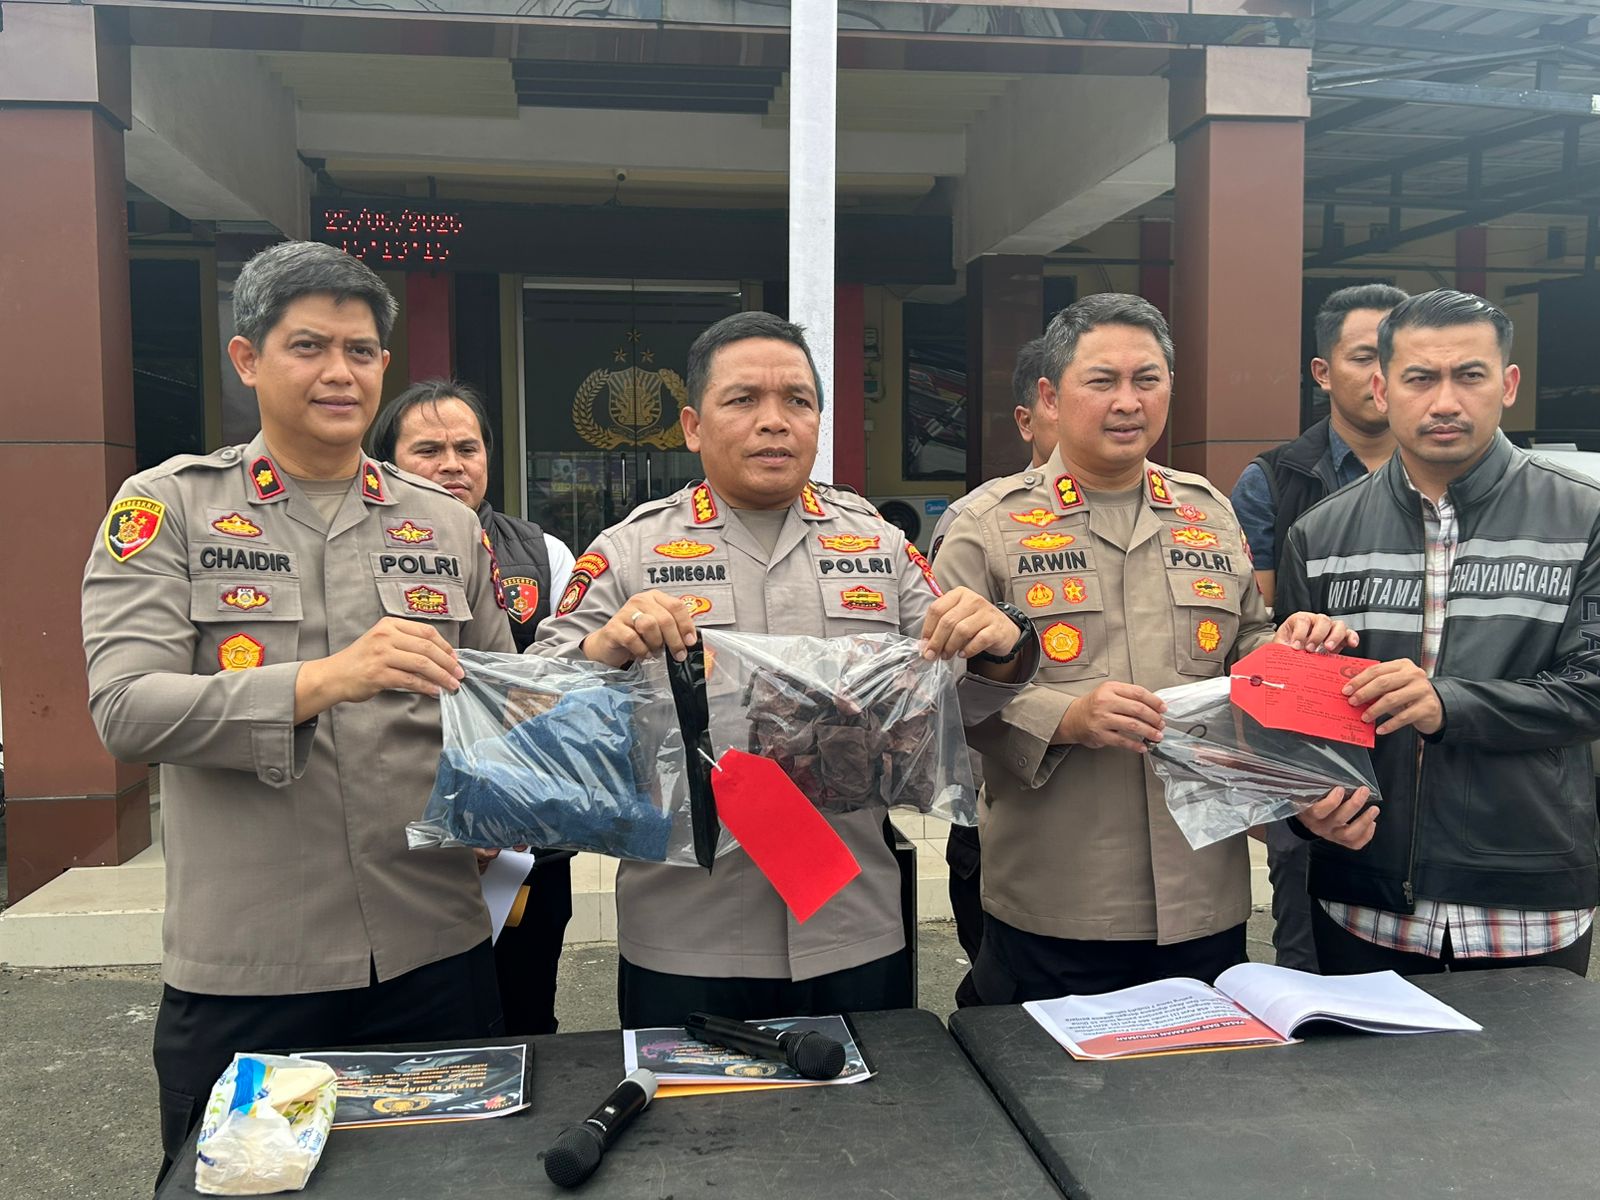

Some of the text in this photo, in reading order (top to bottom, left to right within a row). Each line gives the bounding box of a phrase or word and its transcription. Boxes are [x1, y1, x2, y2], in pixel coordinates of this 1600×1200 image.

[200, 547, 291, 572] CHAIDIR
[380, 555, 459, 577] POLRI
[819, 558, 892, 574] POLRI
[1018, 551, 1087, 574] ARWIN
[1169, 549, 1232, 572] POLRI
[647, 565, 726, 584] T.SIREGAR
[1327, 562, 1573, 609] WIRATAMA BHAYANGKARA
